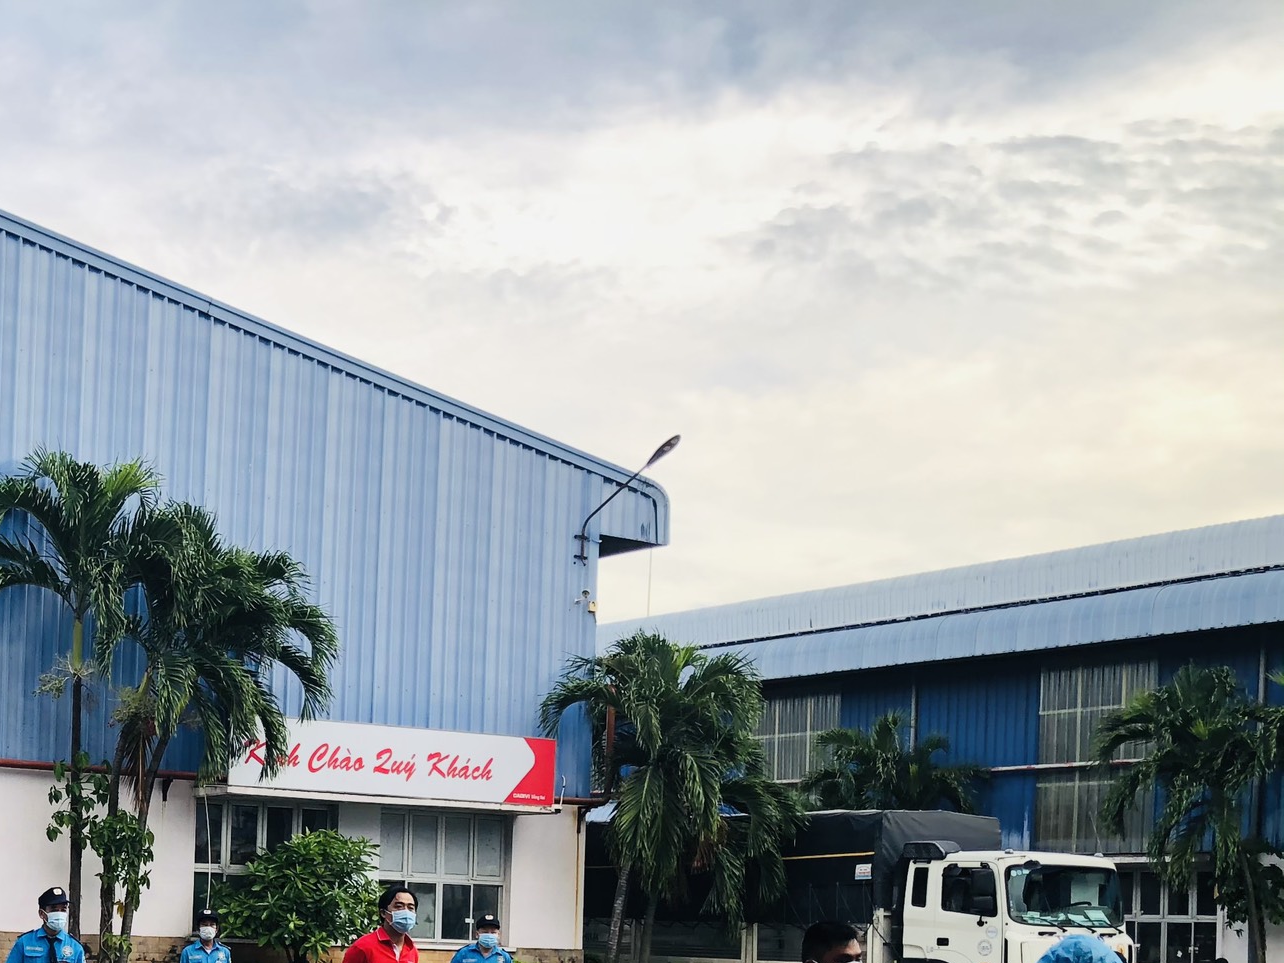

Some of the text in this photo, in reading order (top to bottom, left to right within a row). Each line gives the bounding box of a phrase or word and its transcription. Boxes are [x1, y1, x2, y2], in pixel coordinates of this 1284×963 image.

[308, 743, 365, 773] Chào
[373, 748, 416, 782] Quý
[427, 752, 494, 781] Khách
